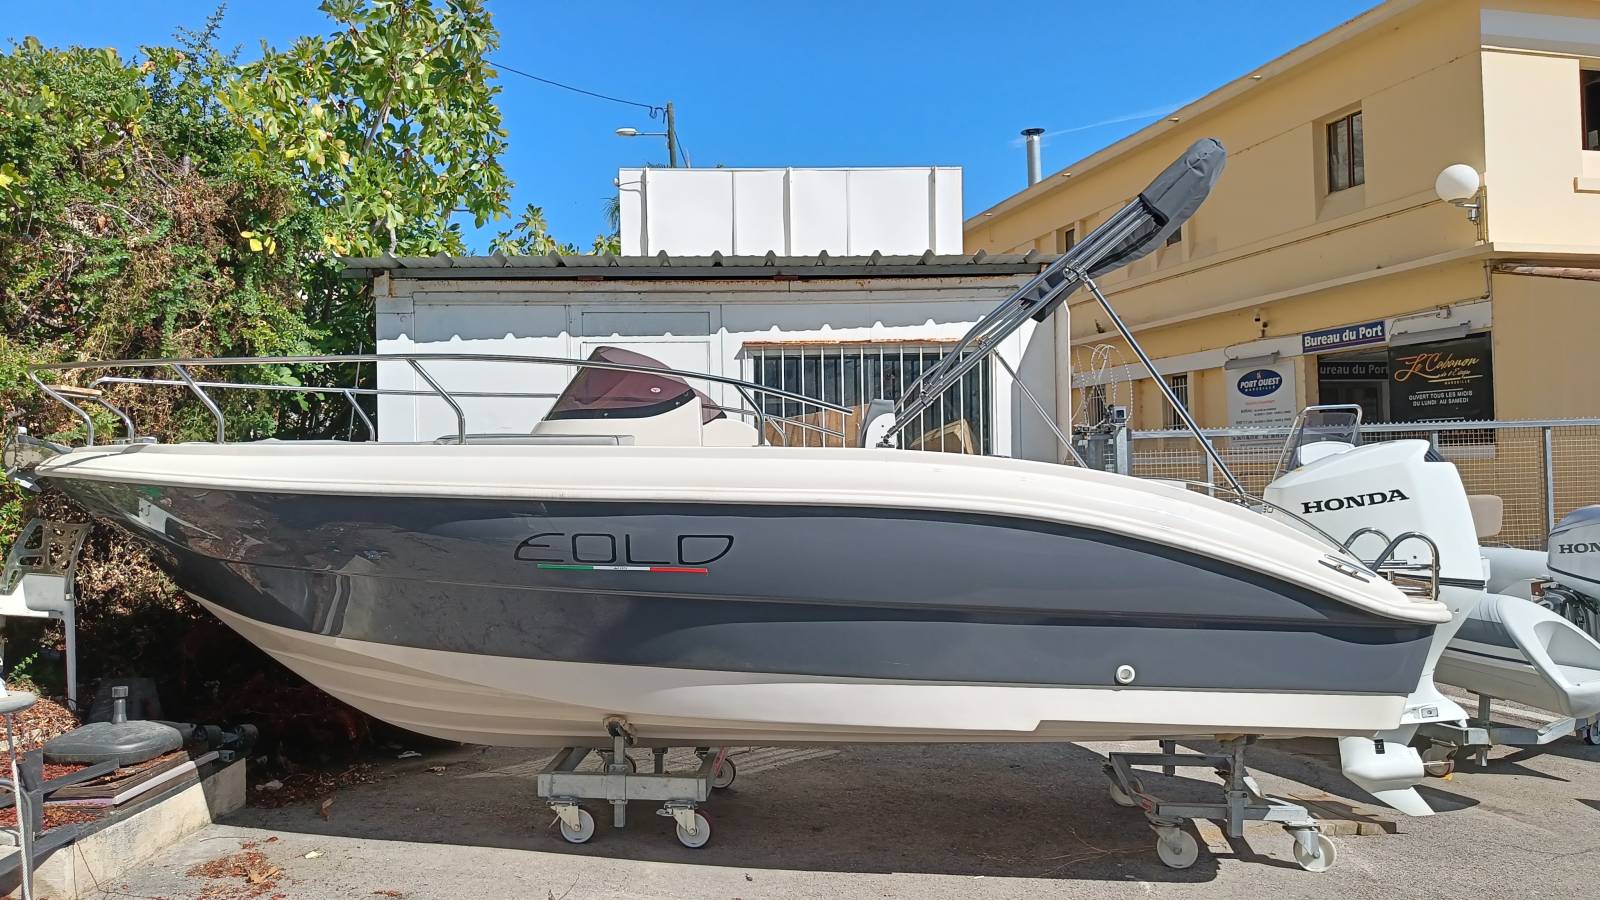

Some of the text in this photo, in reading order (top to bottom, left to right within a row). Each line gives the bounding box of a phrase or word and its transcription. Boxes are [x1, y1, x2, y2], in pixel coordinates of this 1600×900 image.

[1304, 324, 1383, 347] Bureau du Port
[1352, 364, 1366, 375] du
[1240, 377, 1280, 389] PORT OUEST
[1408, 393, 1429, 401] OUVERT
[1301, 489, 1410, 514] HONDA
